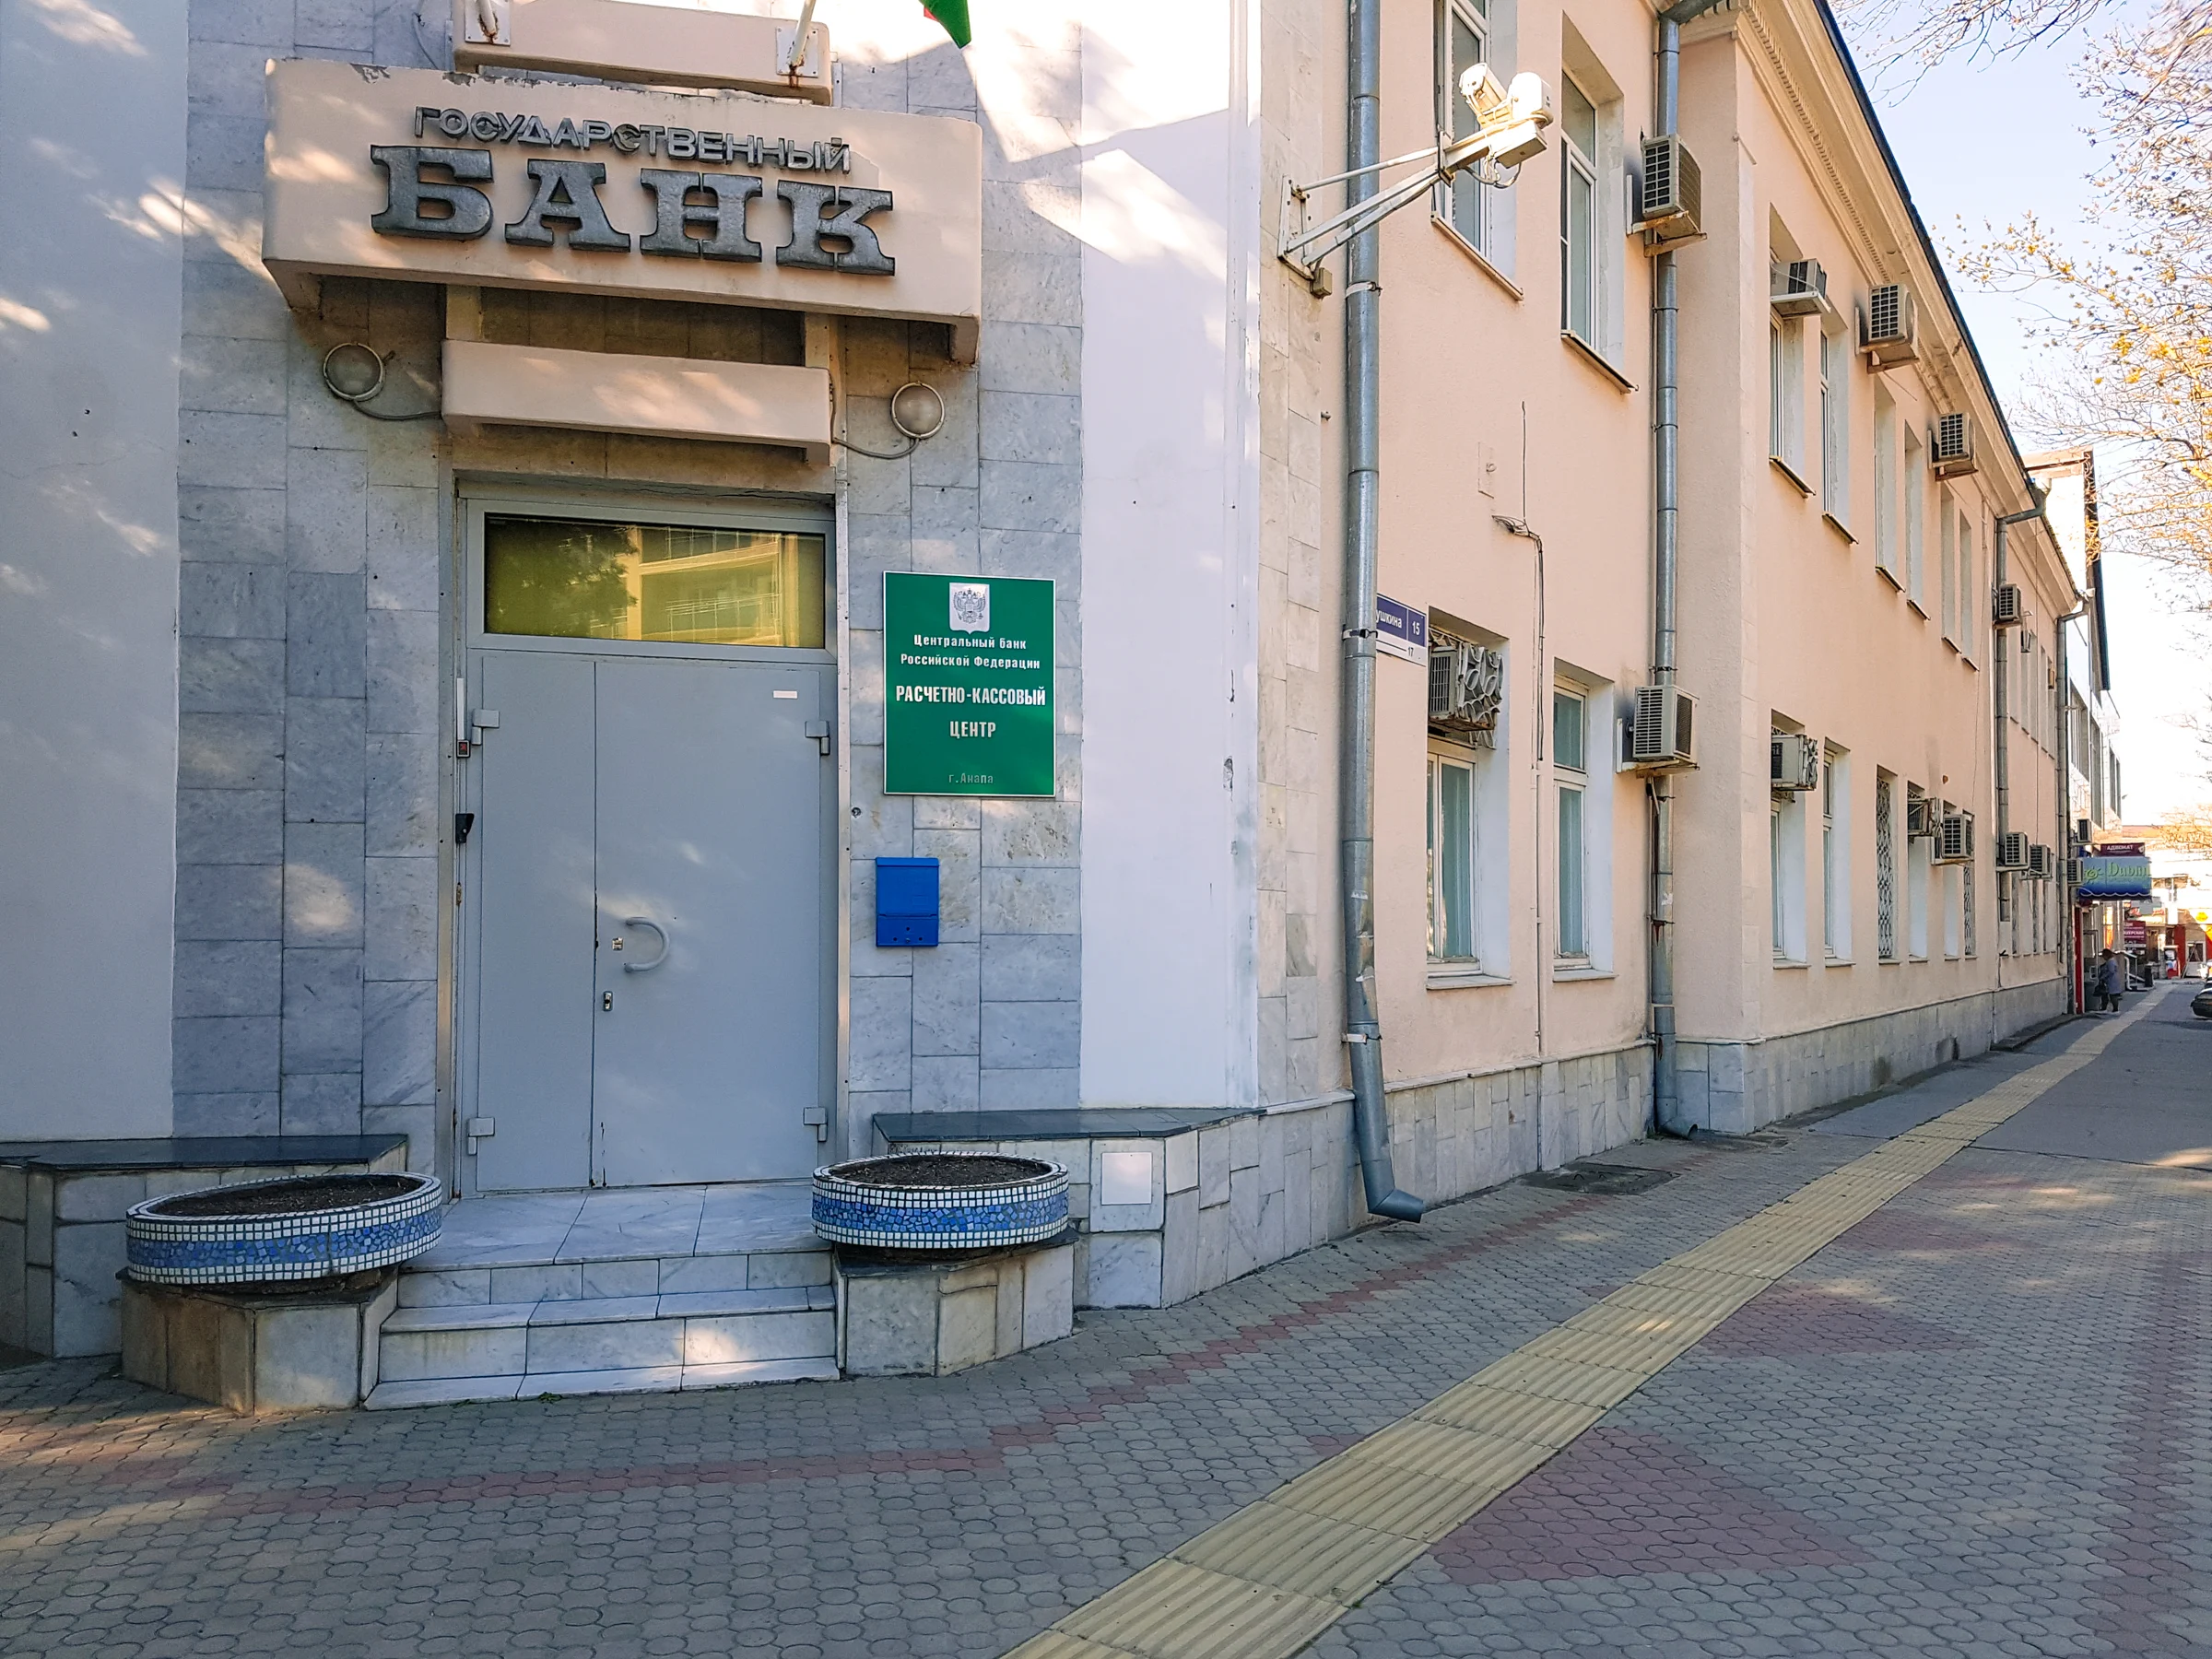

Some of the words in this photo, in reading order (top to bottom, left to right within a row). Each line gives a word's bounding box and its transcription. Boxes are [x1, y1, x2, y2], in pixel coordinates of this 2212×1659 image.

[415, 106, 852, 174] ГОСУДАРСТВЕННЫЙ
[371, 144, 896, 276] БАНК
[1376, 609, 1402, 629] ушкина
[1412, 620, 1420, 635] 15
[913, 634, 995, 649] Центральный
[999, 636, 1027, 650] банк
[1407, 646, 1414, 657] 17
[900, 653, 970, 666] Российской
[973, 655, 1041, 670] Федерации
[895, 685, 1046, 706] РАСЧЕТНО-КАССОВЫЙ
[949, 720, 996, 739] ЦЕНТР
